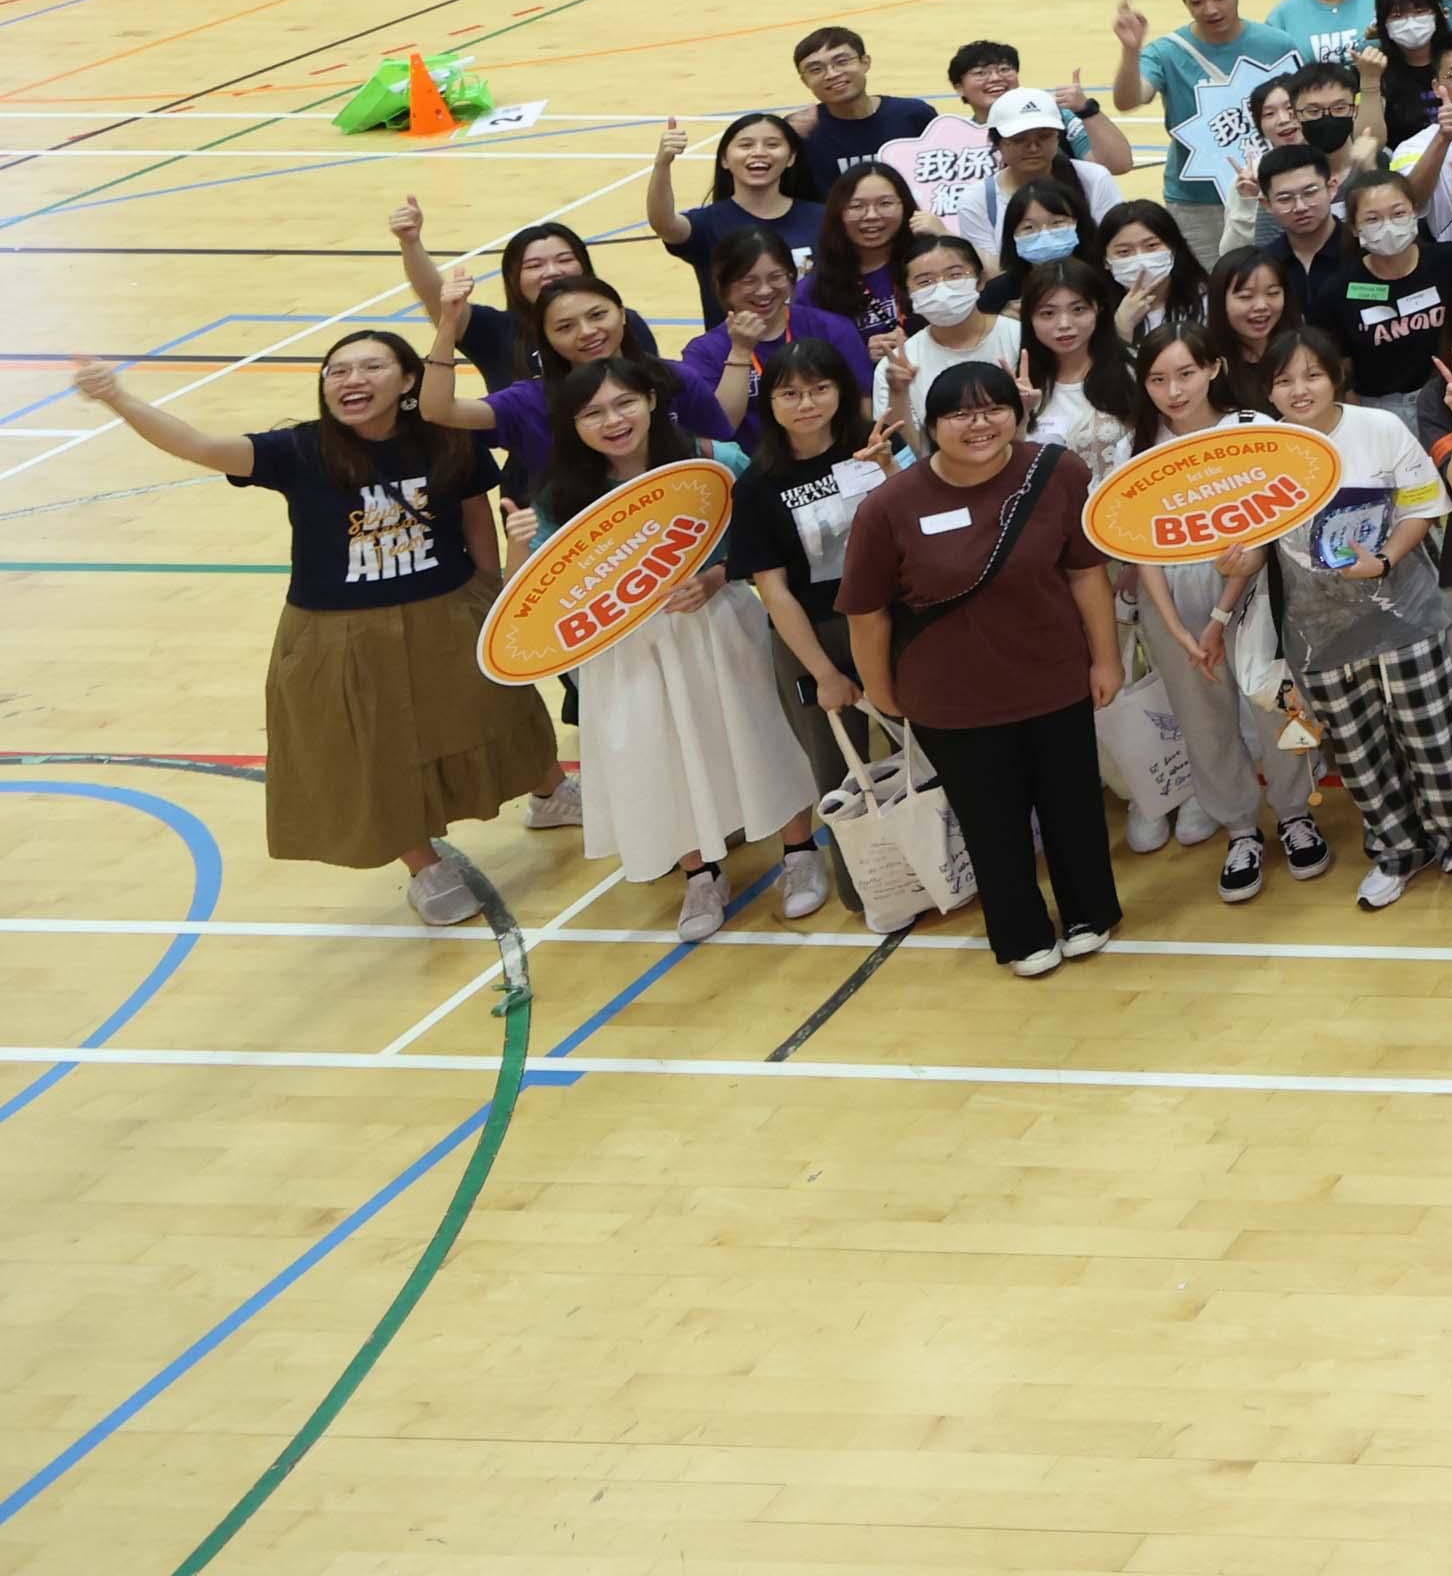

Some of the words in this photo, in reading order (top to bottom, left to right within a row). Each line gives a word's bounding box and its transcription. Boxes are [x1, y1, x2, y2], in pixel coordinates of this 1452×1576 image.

[915, 147, 996, 184] 我係
[931, 184, 965, 217] 組
[1120, 454, 1202, 502] WELCOME
[1197, 441, 1279, 474] ABOARD
[1161, 467, 1267, 511] LEARNING
[1184, 469, 1202, 484] let
[1203, 463, 1224, 479] the
[1149, 474, 1309, 549] BEGIN!
[513, 539, 590, 620] WELCOME
[588, 487, 666, 543] ABOARD
[559, 518, 662, 609] LEARNING
[578, 549, 595, 570] let
[595, 535, 615, 558] the
[555, 513, 710, 652] BEGIN!
